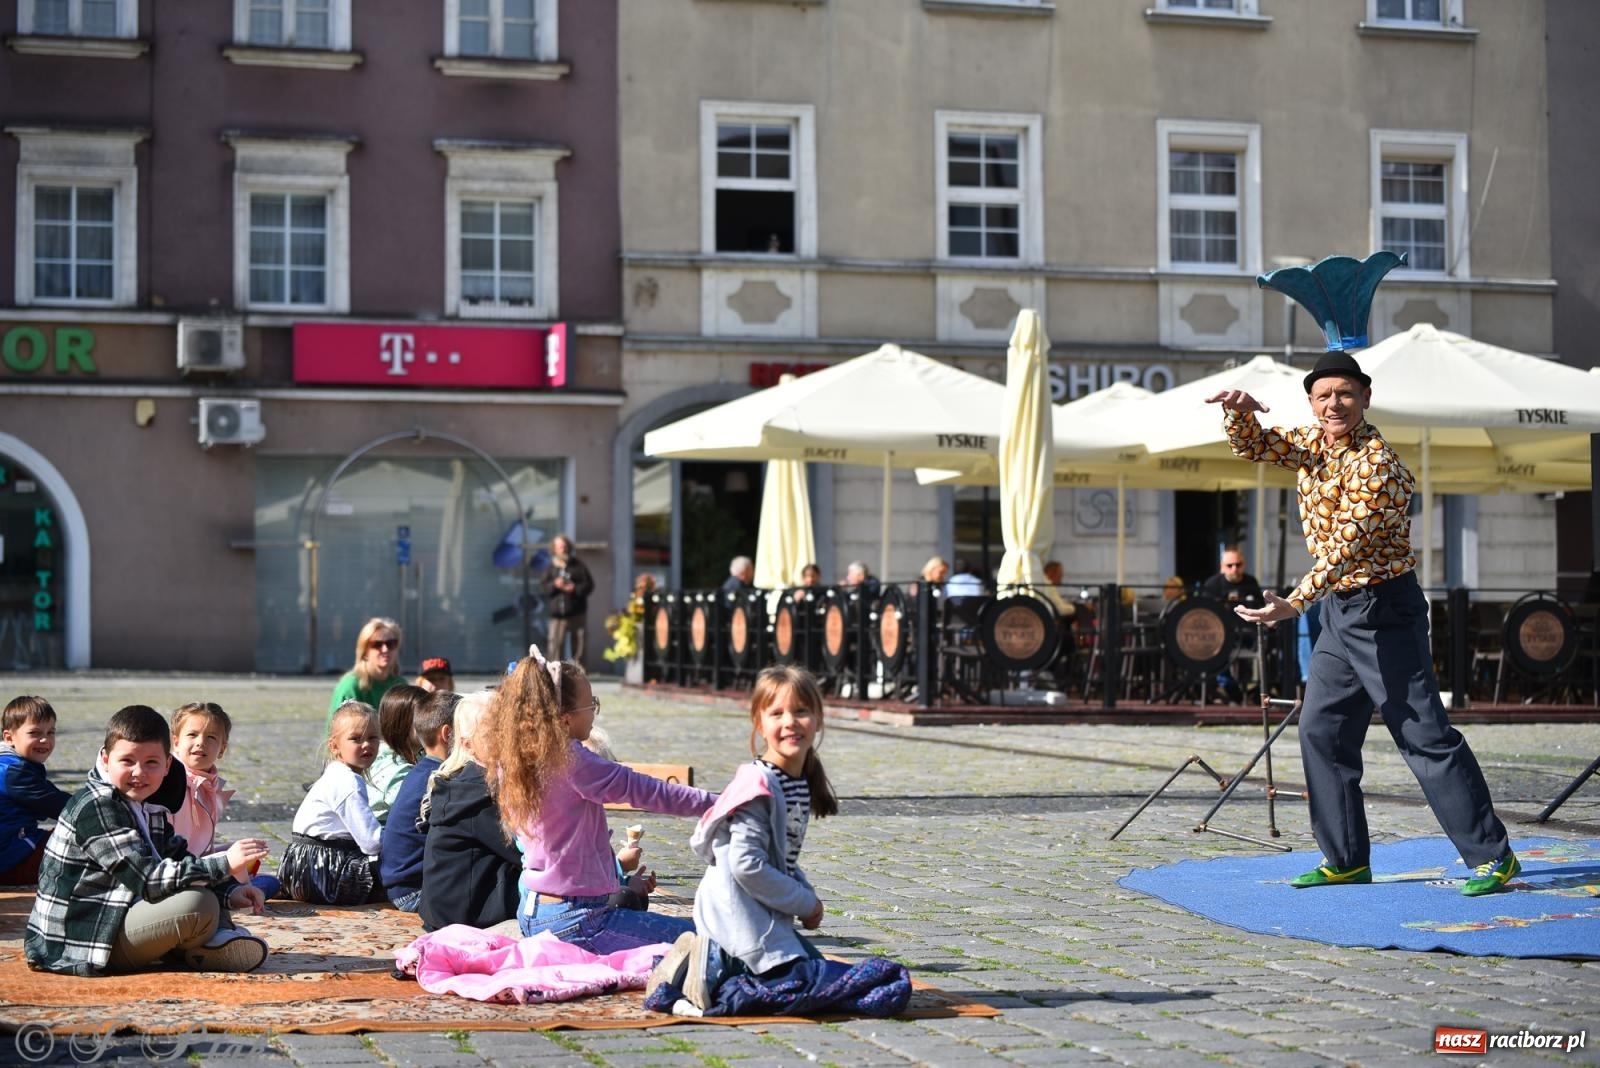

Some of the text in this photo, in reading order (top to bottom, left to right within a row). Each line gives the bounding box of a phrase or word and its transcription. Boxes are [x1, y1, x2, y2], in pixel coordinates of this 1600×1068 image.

[3, 325, 97, 373] OR
[1516, 408, 1568, 425] TYSKIE
[936, 433, 988, 450] TYSKIE
